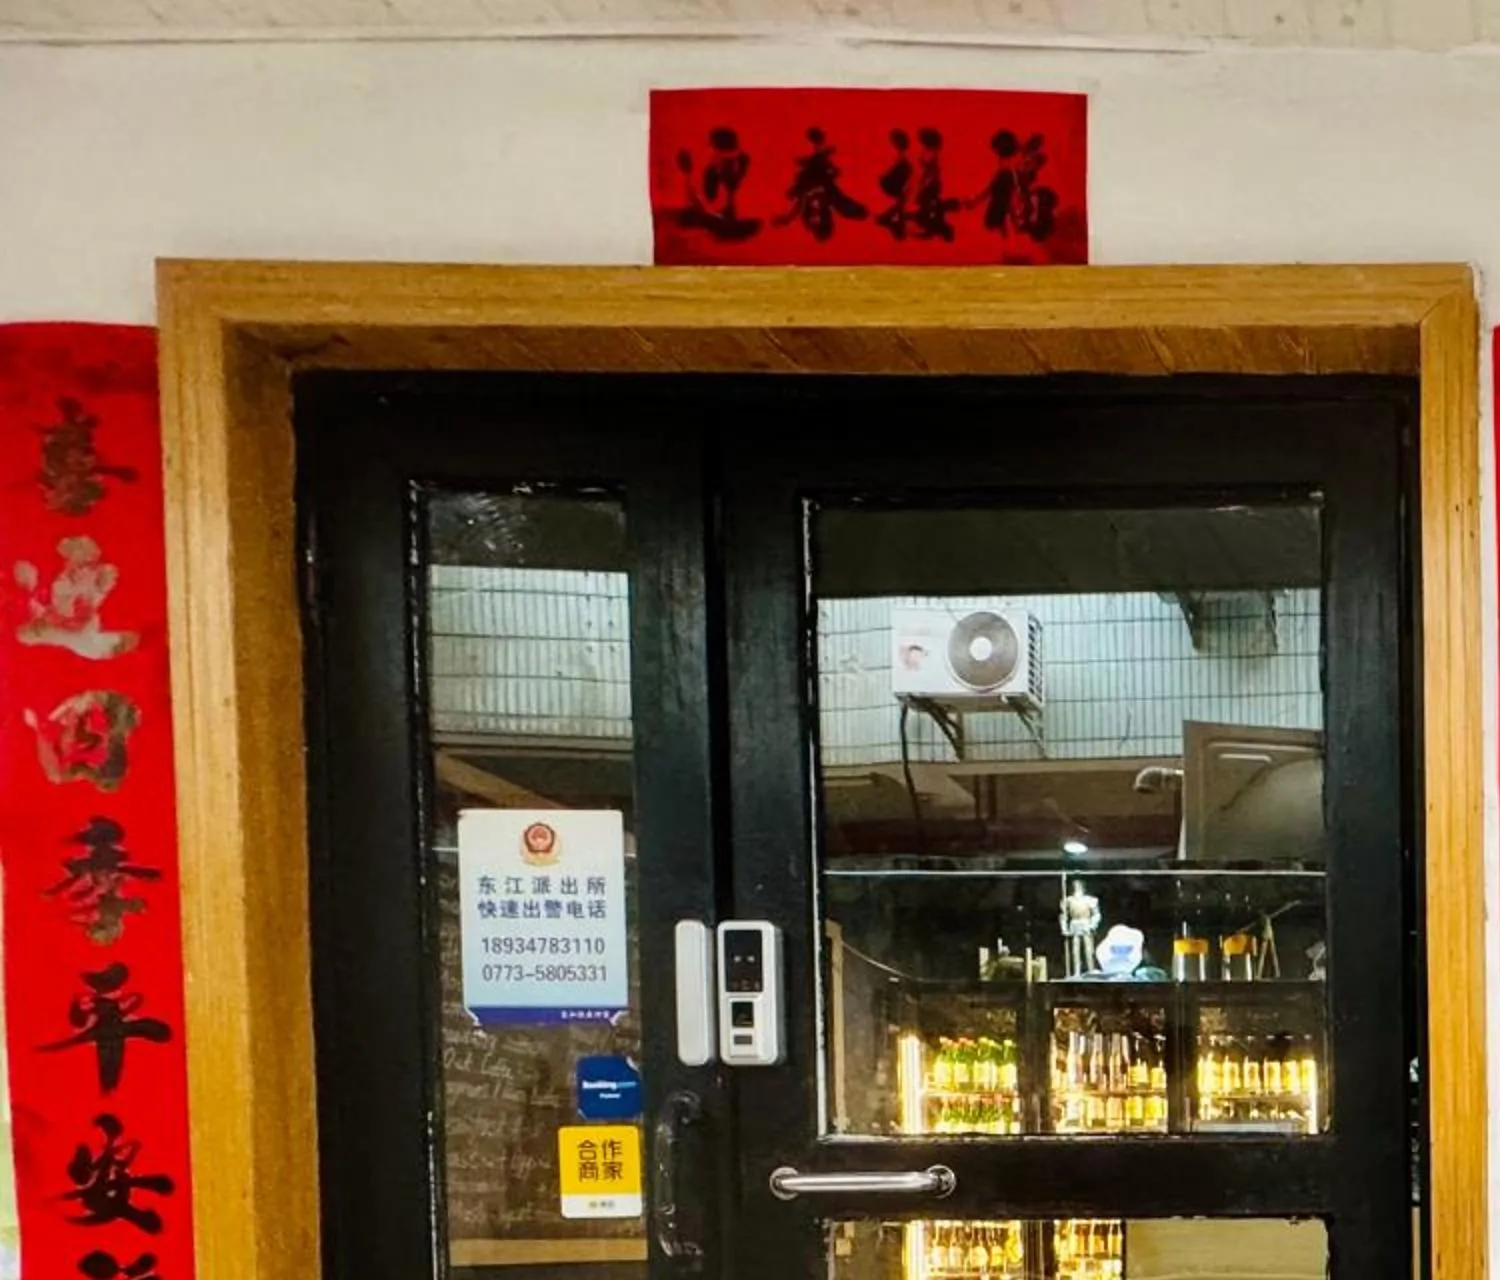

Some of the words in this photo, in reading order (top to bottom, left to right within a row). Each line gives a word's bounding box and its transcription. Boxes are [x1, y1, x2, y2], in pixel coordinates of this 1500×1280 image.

[478, 875, 606, 895] 东江派出所
[478, 899, 607, 920] 快速出警电话
[482, 937, 605, 955] 18934783110
[482, 964, 607, 982] 0773-5805331
[578, 1139, 623, 1161] 合作
[578, 1161, 624, 1181] 商家
